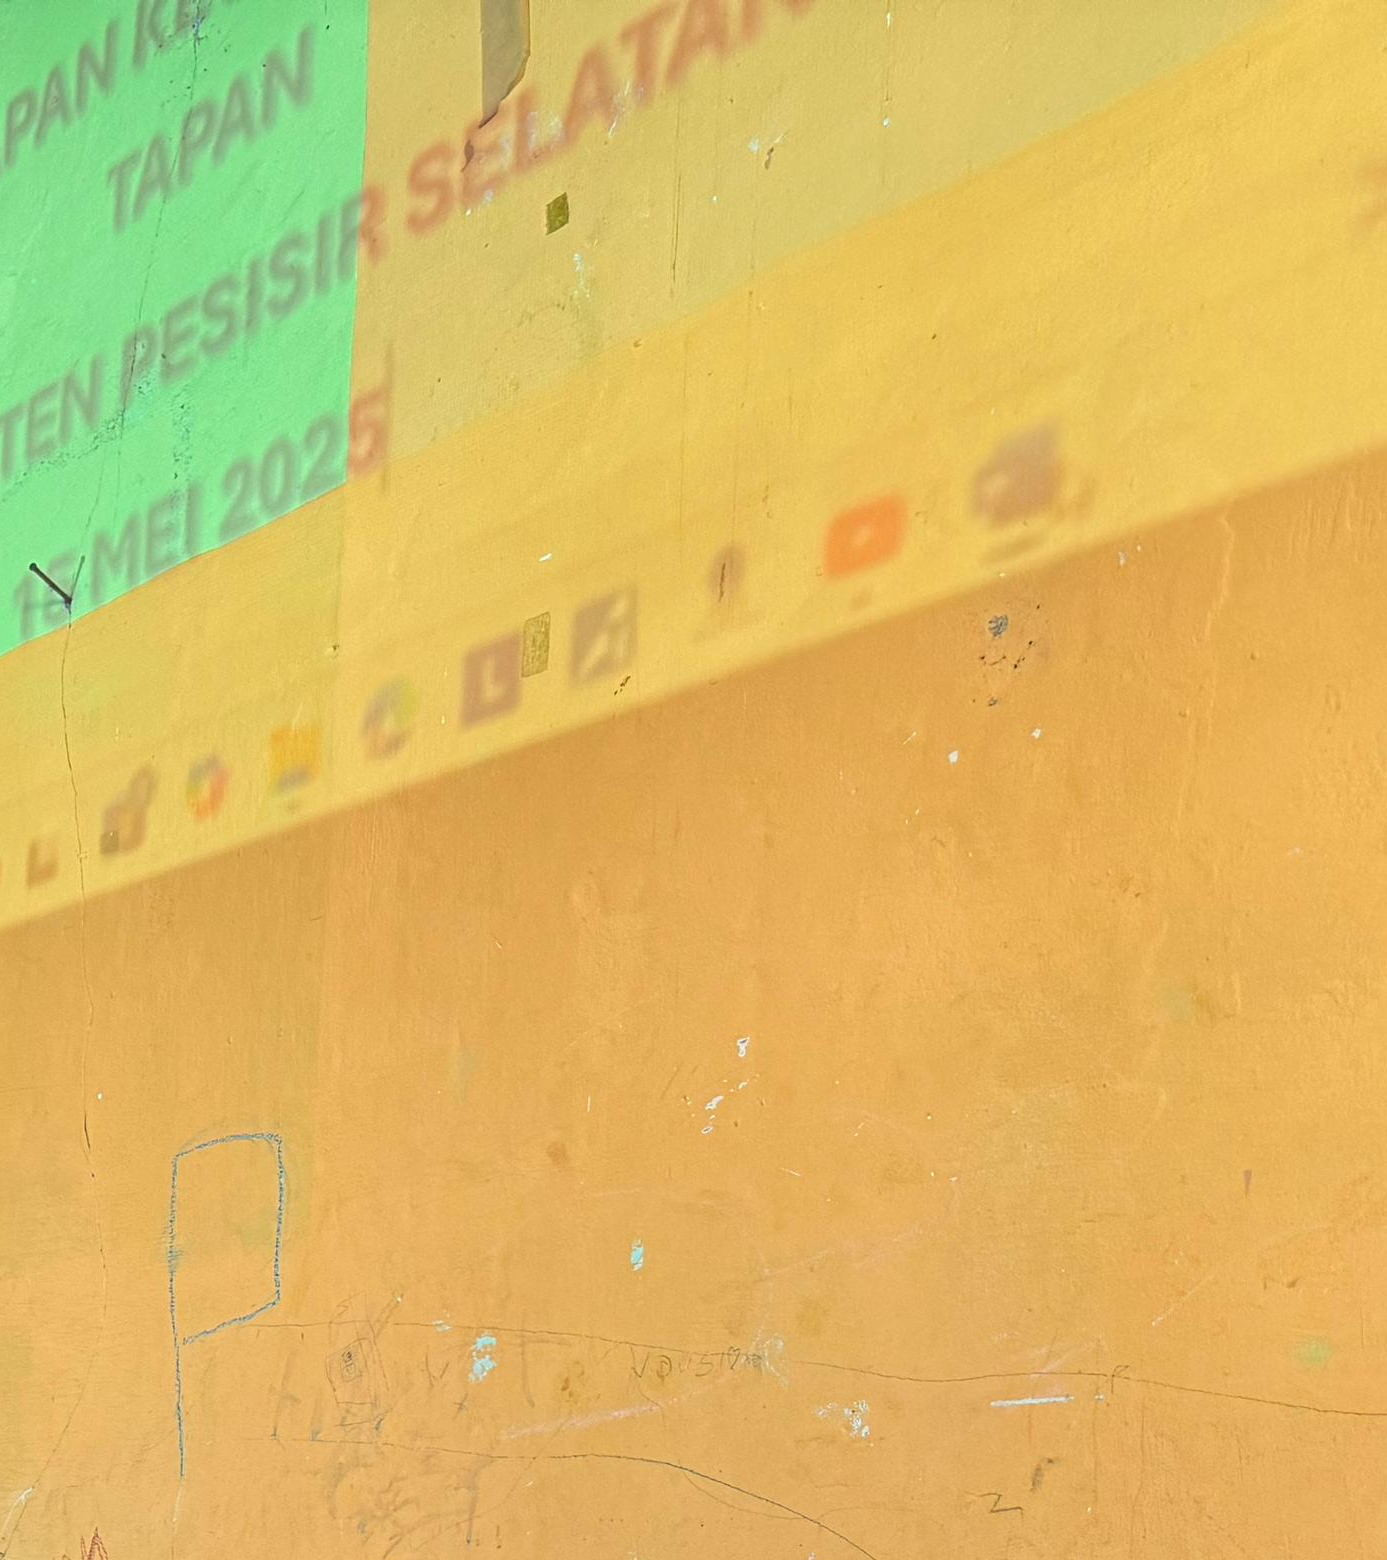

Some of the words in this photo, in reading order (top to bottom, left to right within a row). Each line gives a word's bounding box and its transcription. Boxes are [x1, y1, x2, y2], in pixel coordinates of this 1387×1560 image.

[107, 21, 315, 235] TAPAN
[119, 184, 389, 408] PESISIR
[89, 480, 205, 604] MEI
[219, 384, 389, 546] 2025
